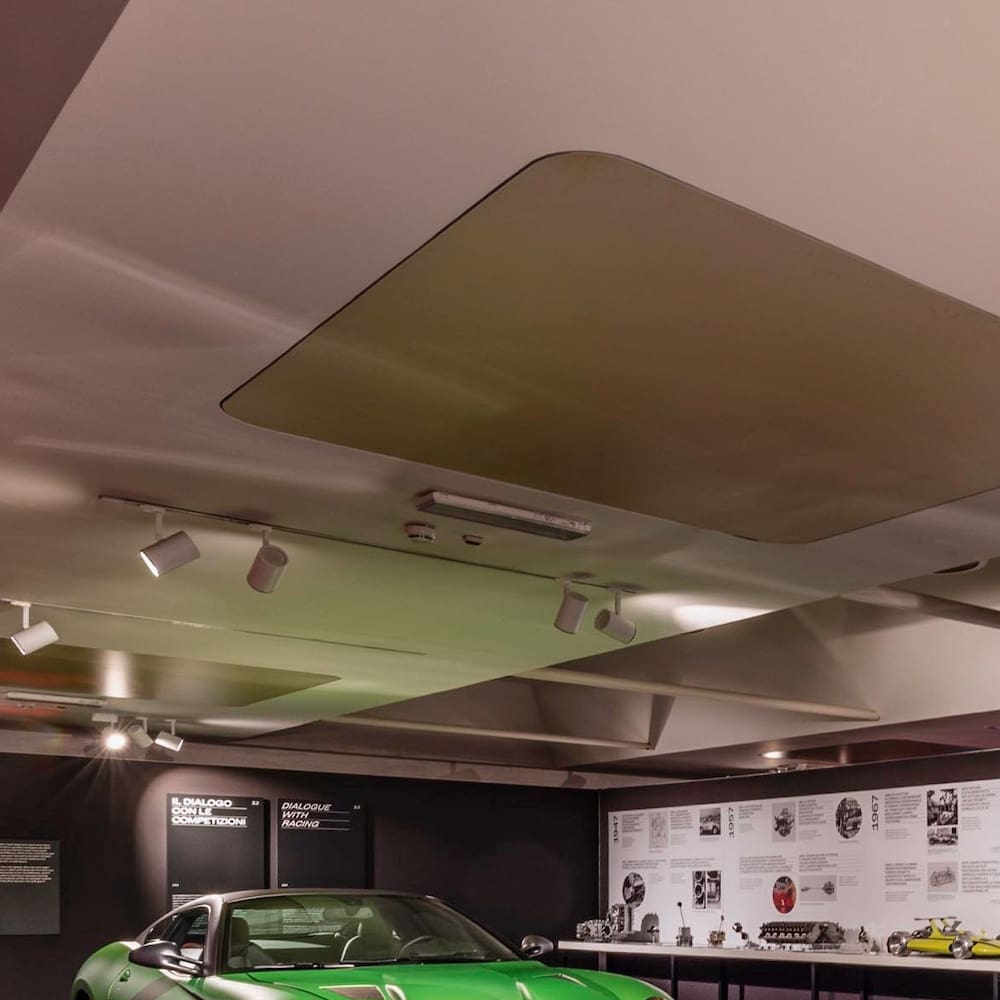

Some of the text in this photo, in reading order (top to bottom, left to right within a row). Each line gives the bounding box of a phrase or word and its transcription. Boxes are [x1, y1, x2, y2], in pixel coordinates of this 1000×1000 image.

[171, 797, 233, 808] IL DIALOGO
[280, 802, 332, 812] DIALOGUE
[171, 807, 213, 816] CON LE
[281, 811, 308, 820] WITH
[871, 794, 879, 831] 1967
[171, 816, 246, 826] COMPETIZIONI
[281, 819, 320, 829] RACING
